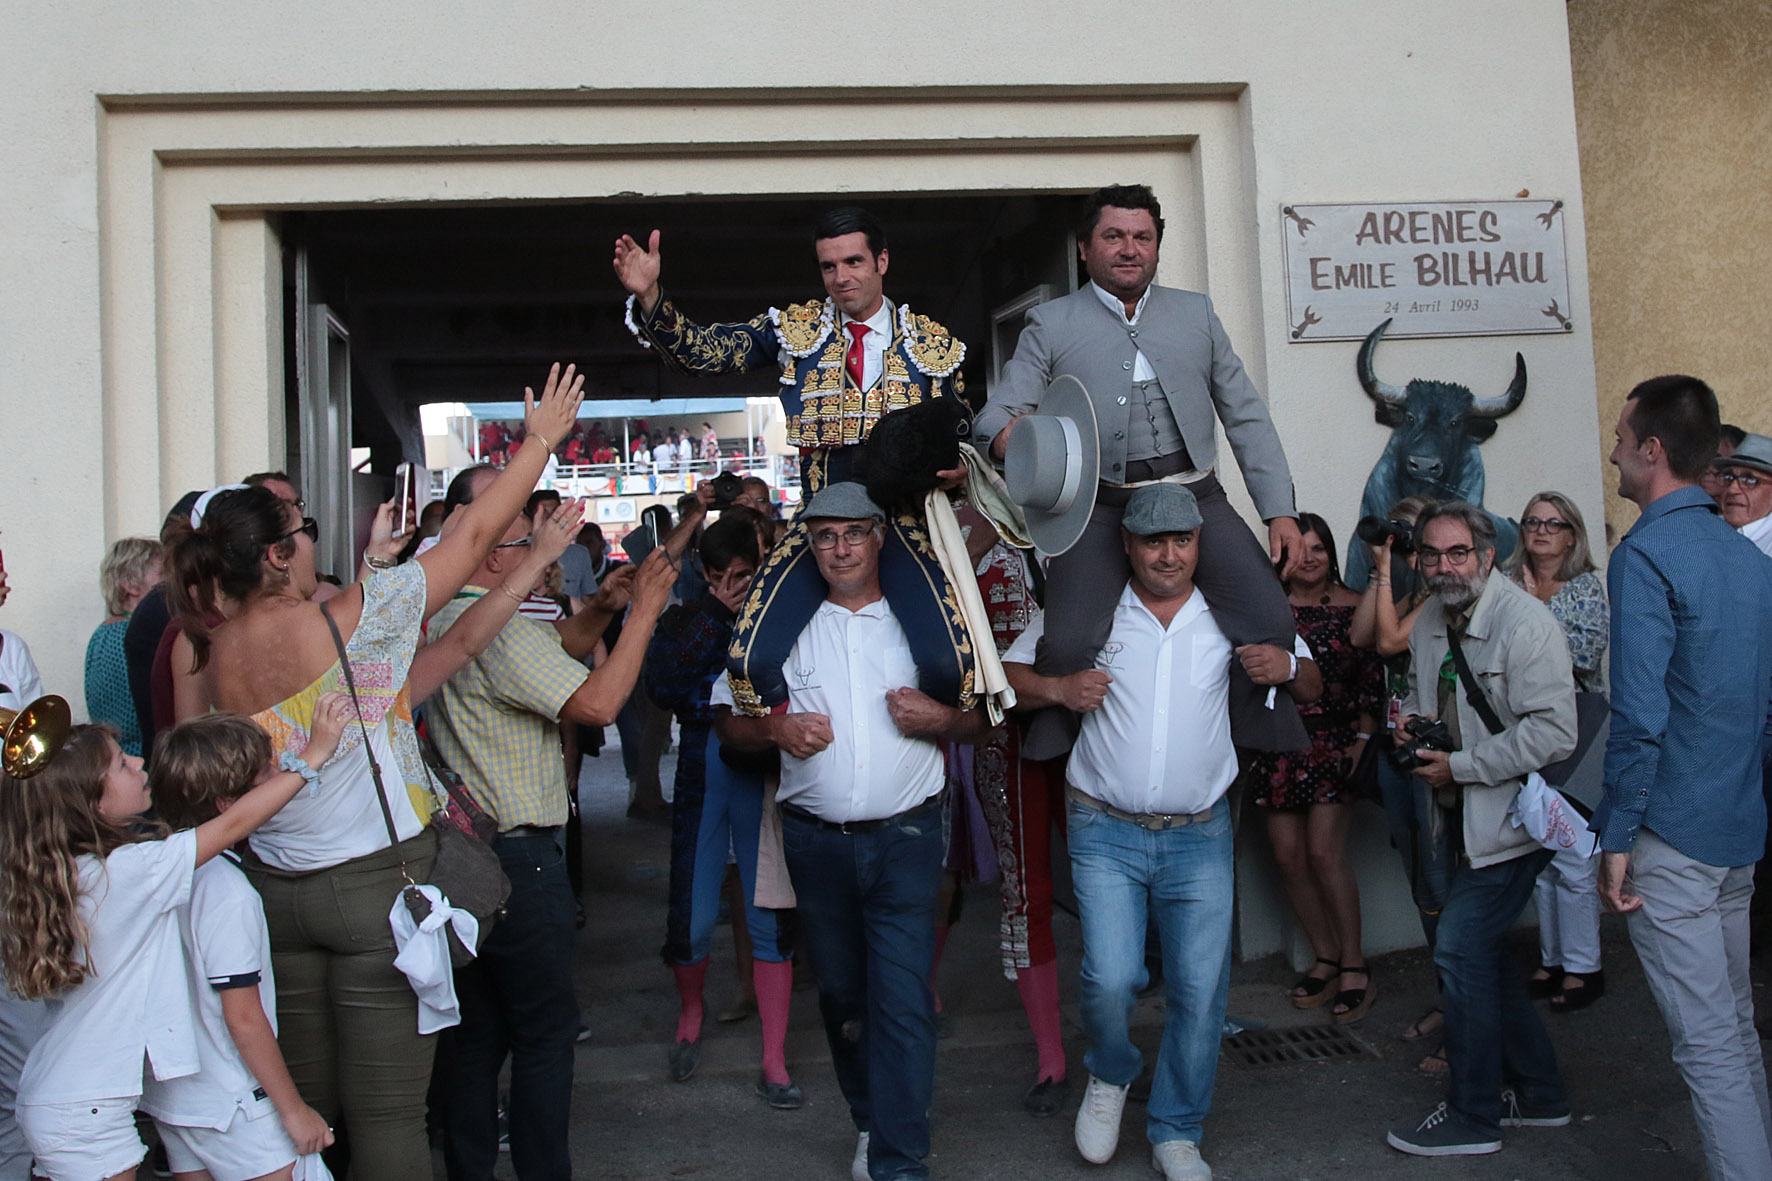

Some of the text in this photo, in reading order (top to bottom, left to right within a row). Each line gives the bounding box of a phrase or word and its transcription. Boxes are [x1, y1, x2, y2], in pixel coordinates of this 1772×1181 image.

[1355, 210, 1501, 246] ARENES
[1309, 250, 1549, 291] EMILE BILHAU
[1384, 299, 1479, 314] 24 Avril 1993
